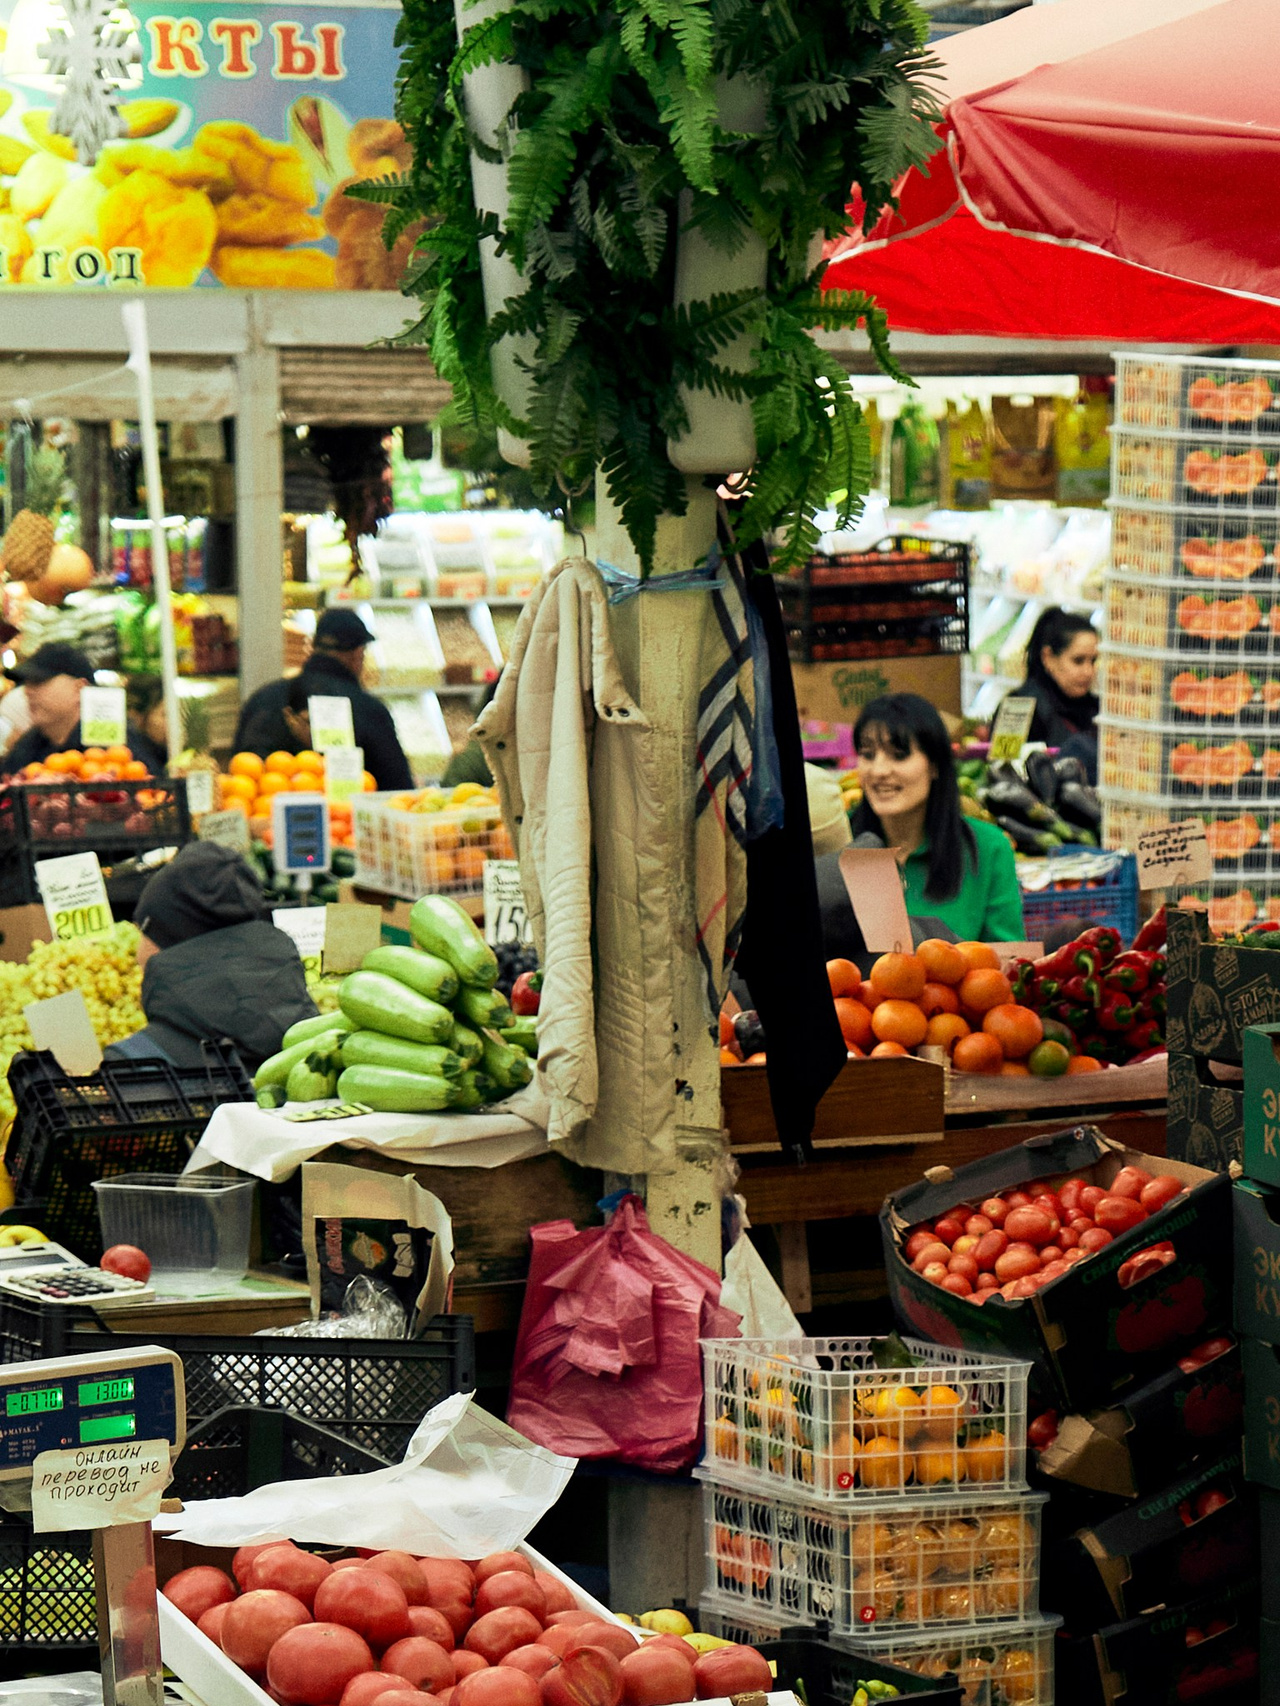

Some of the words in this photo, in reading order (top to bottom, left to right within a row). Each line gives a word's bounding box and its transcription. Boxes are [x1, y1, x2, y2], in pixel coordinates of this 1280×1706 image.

[154, 22, 341, 76] КТЫ
[41, 1465, 129, 1486] перевод
[140, 1460, 161, 1475] не
[50, 1480, 141, 1501] проходит
